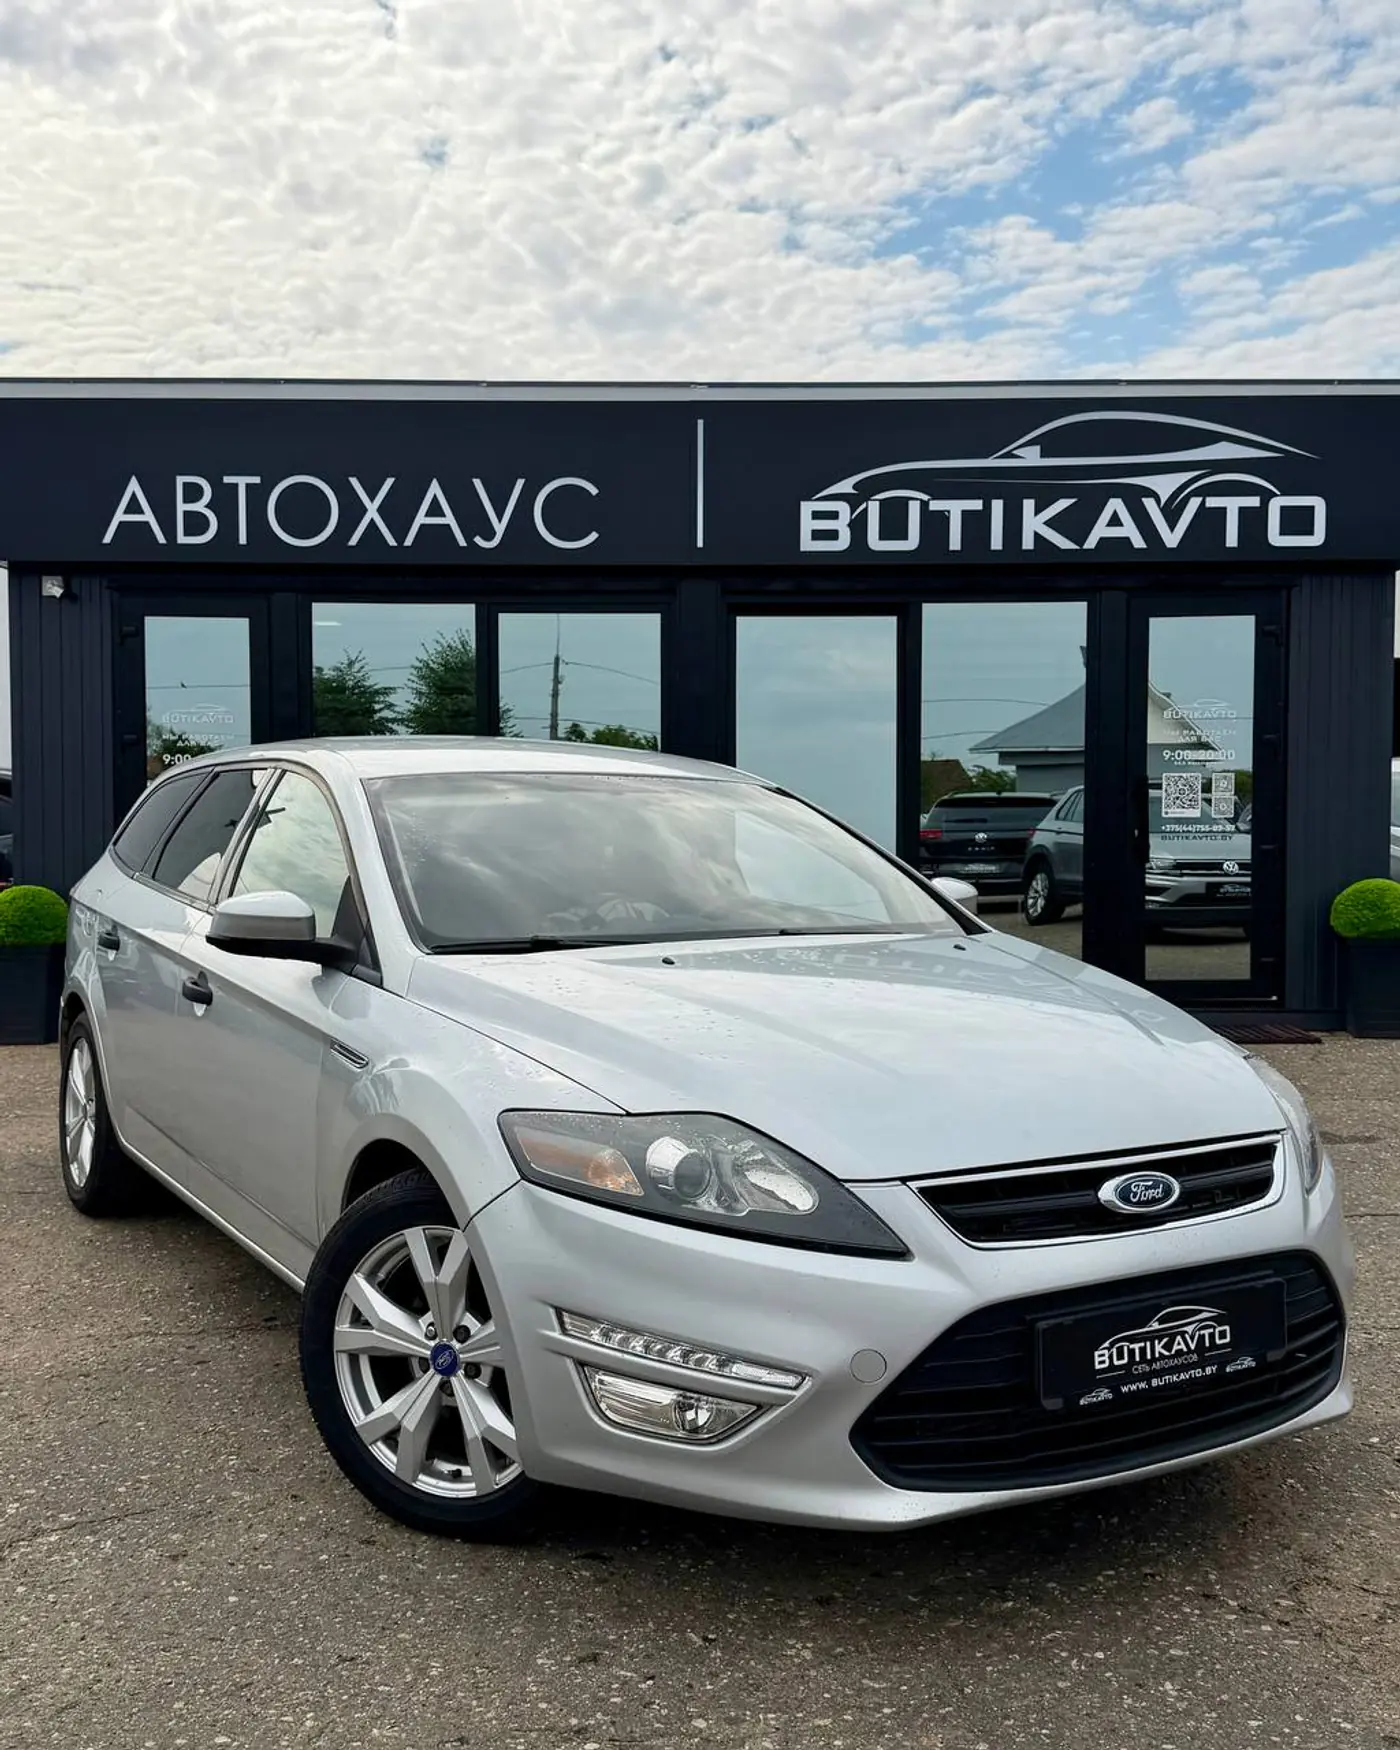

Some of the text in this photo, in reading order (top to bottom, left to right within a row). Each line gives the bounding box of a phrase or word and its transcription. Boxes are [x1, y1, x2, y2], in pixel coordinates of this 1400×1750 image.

[102, 474, 600, 550] АВТОХАУС
[799, 494, 1327, 552] BUTIKAVTO
[1130, 1181, 1165, 1203] Ford
[1094, 1325, 1231, 1370] BUTIKAVTO
[1151, 1364, 1218, 1388] BUTIKAVTO.BY
